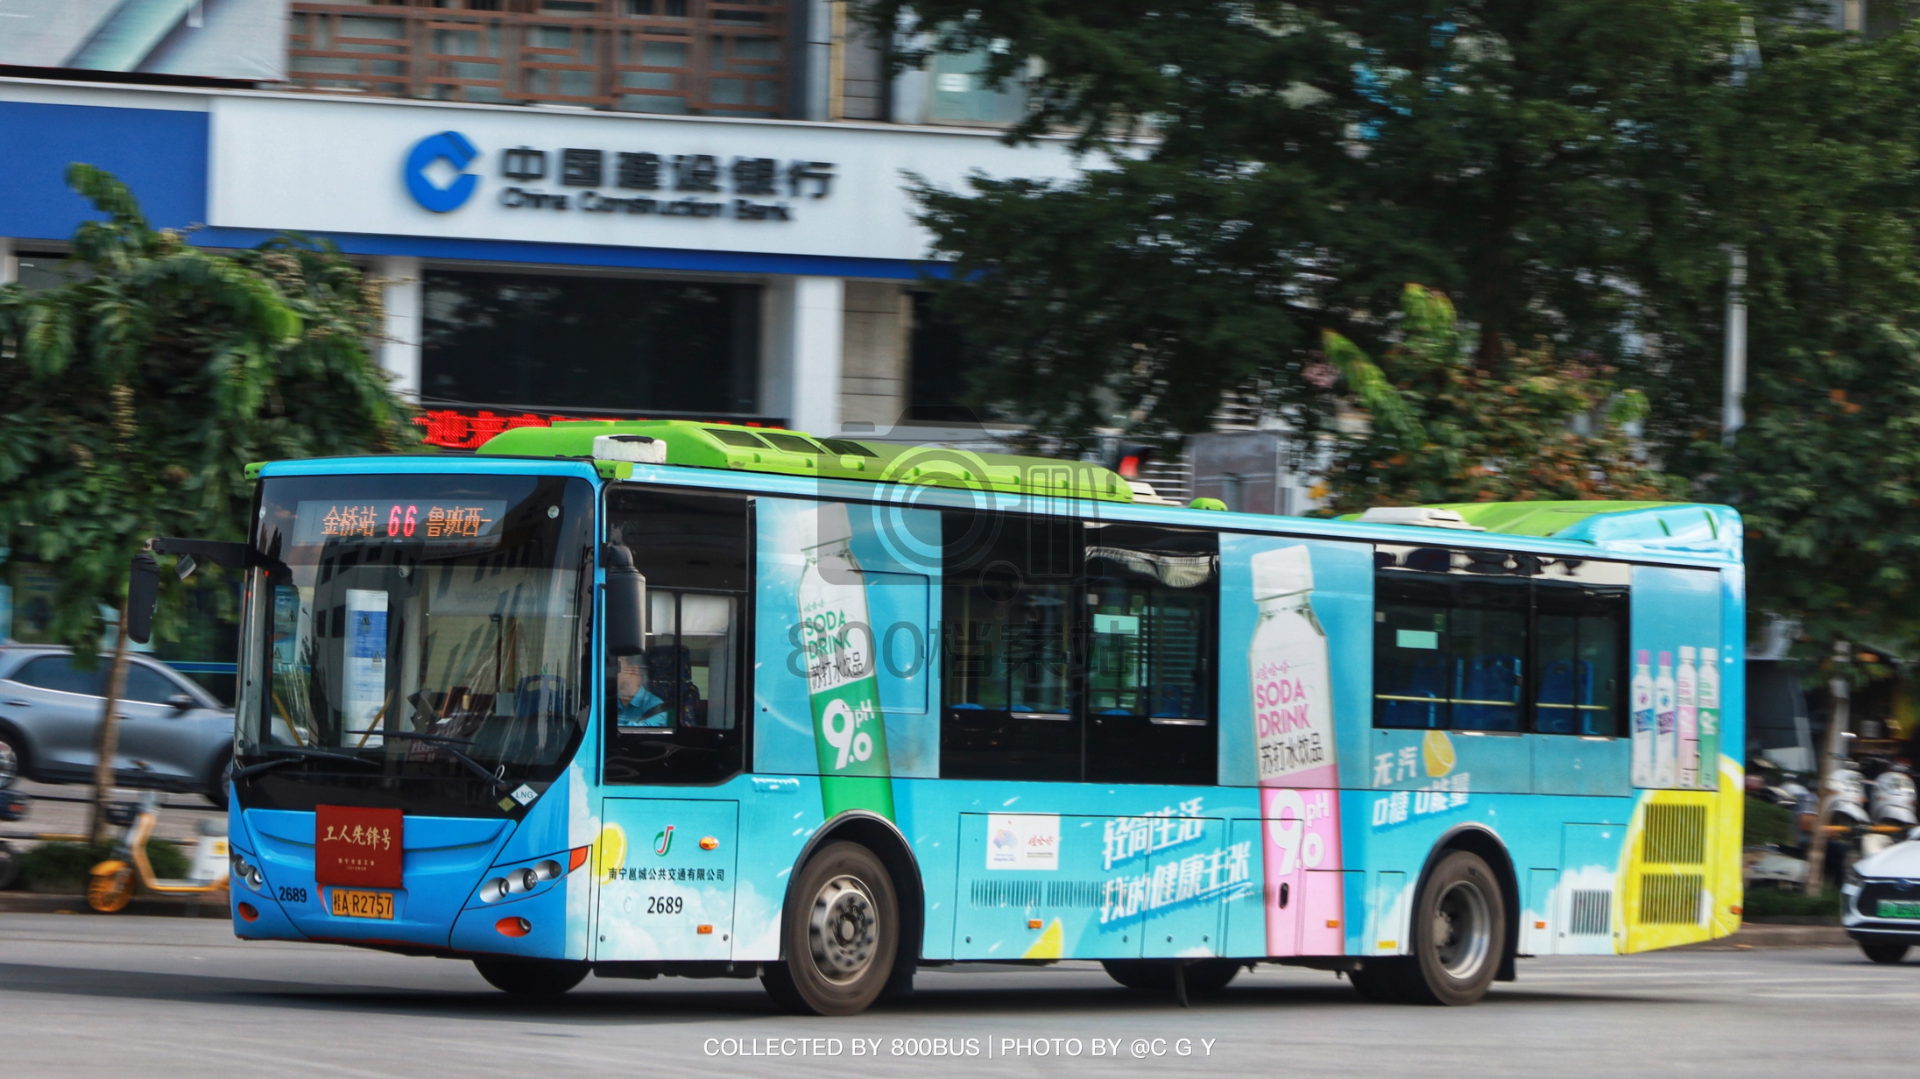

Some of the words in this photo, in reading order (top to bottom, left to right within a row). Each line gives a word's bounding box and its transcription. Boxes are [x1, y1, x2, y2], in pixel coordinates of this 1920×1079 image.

[501, 145, 837, 200] 中国建设银行
[502, 187, 568, 211] China
[577, 190, 726, 216] Construction
[736, 198, 794, 222] Bank
[321, 506, 377, 537] 金桥站
[388, 505, 418, 537] 66
[805, 608, 847, 637] SODA
[808, 629, 852, 660] DRINK
[1256, 678, 1306, 709] SODA
[1258, 703, 1311, 738] DRINK
[1260, 732, 1324, 774] 苏打水饮品
[515, 791, 534, 799] LNG
[323, 824, 392, 851] 工人先锋号
[1102, 796, 1204, 870] 轻简生活
[607, 867, 725, 881] 南宁邕城公共交通有限公司
[1100, 841, 1251, 924] 我的健康主张
[279, 885, 307, 903] 2689
[647, 896, 683, 914] 2689
